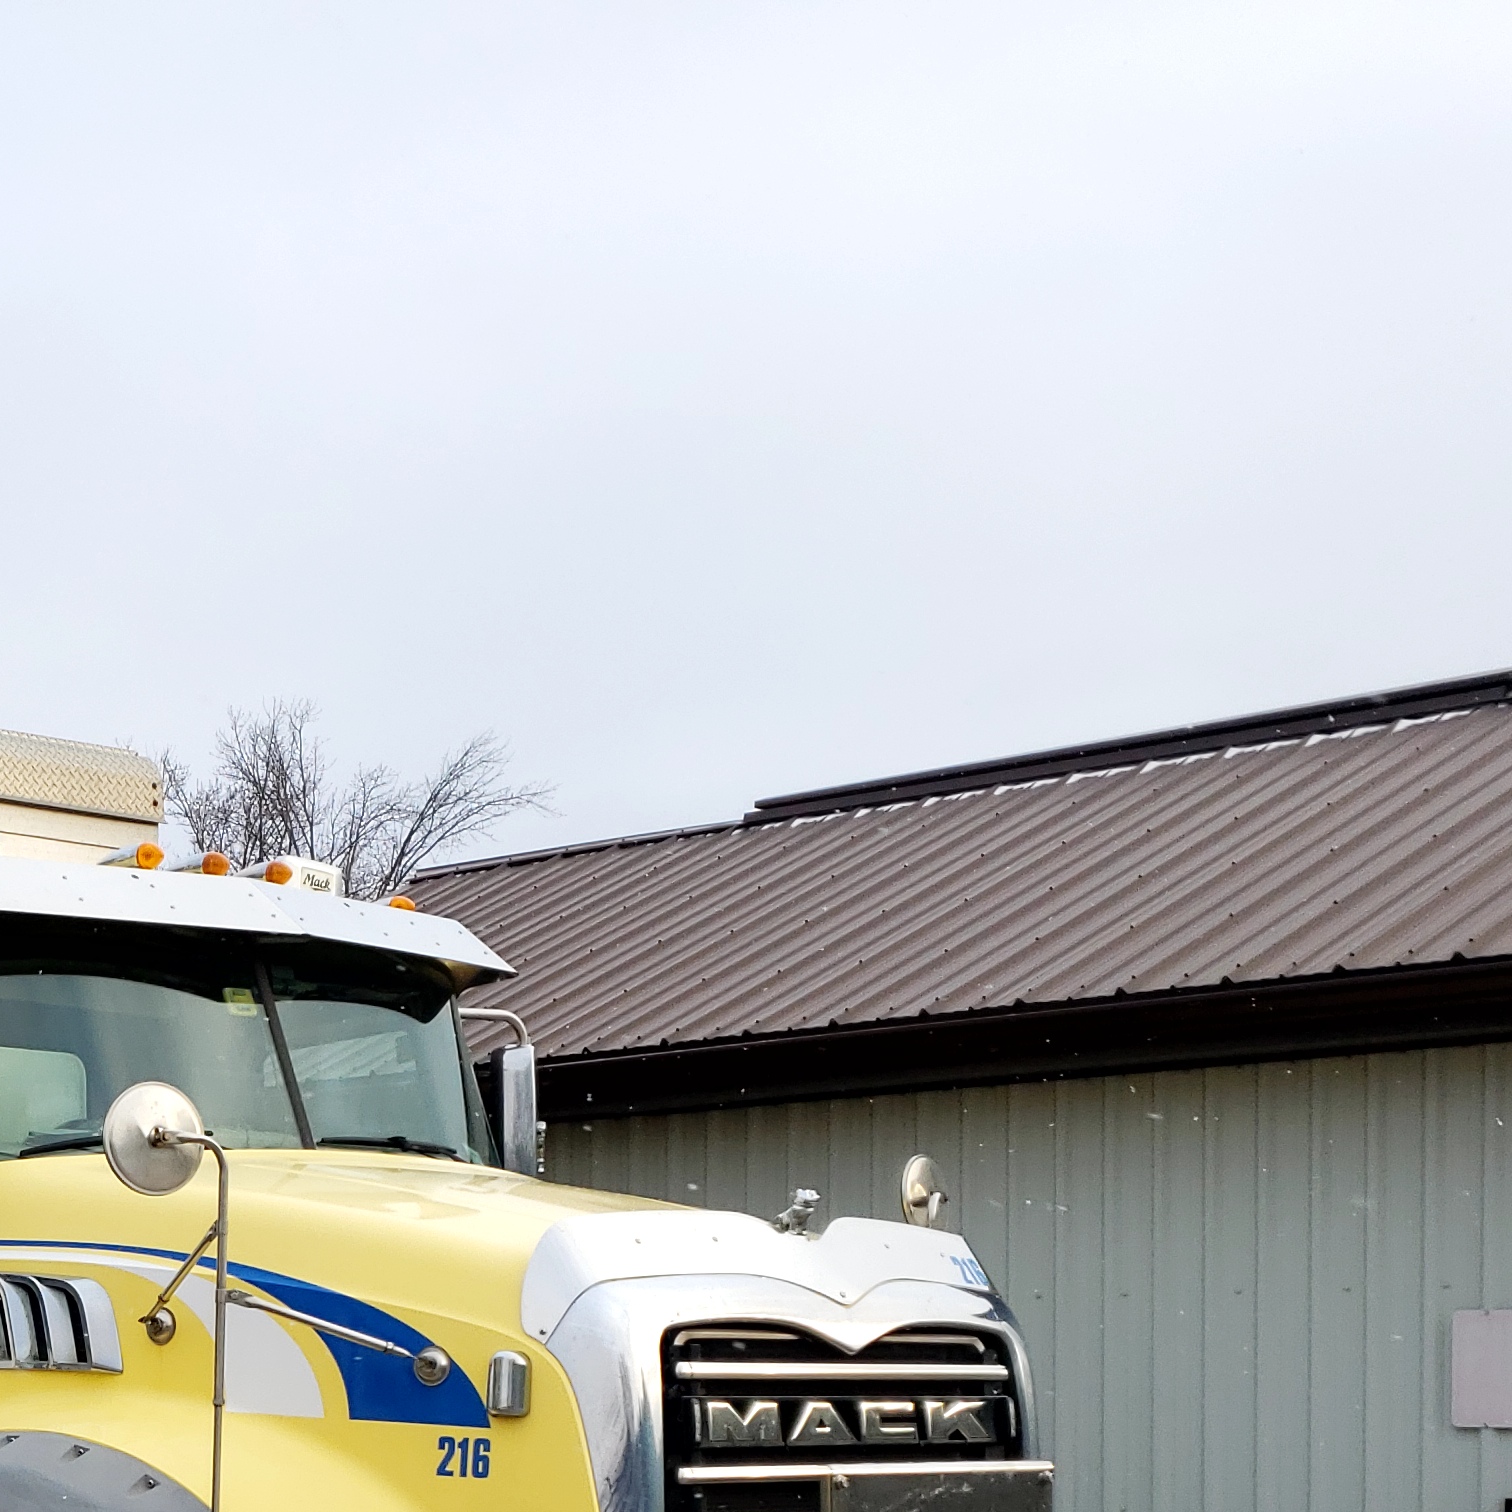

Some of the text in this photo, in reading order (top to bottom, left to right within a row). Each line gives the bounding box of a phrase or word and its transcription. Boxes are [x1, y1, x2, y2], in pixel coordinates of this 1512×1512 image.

[303, 873, 331, 891] Mack
[704, 1400, 998, 1445] MACK
[436, 1435, 492, 1479] 216
